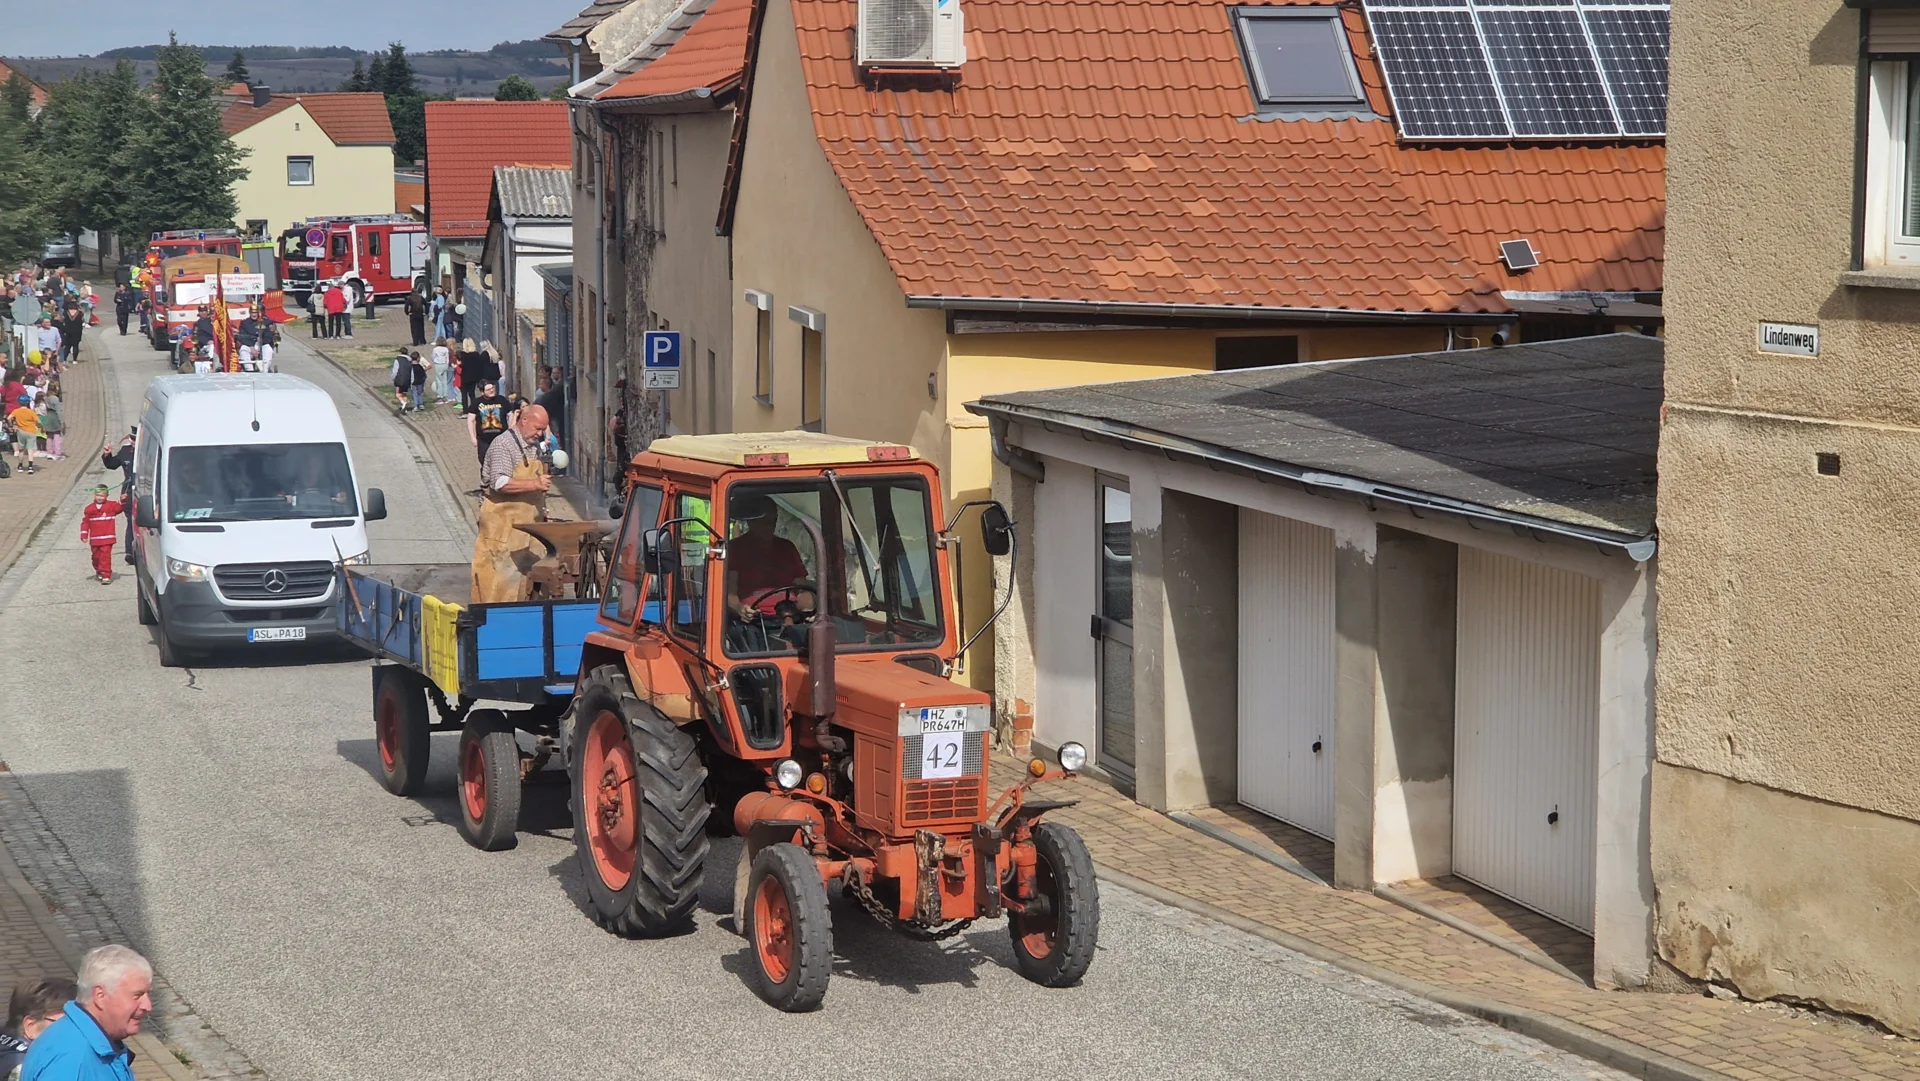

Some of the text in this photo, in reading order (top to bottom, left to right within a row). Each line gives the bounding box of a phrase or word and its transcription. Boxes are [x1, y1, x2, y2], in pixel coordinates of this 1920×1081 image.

[1764, 326, 1814, 353] Lindenweg
[653, 336, 672, 363] P
[254, 628, 304, 639] ASL PA18
[930, 709, 945, 720] HZ
[922, 720, 965, 732] PR647H
[926, 742, 958, 769] 42
